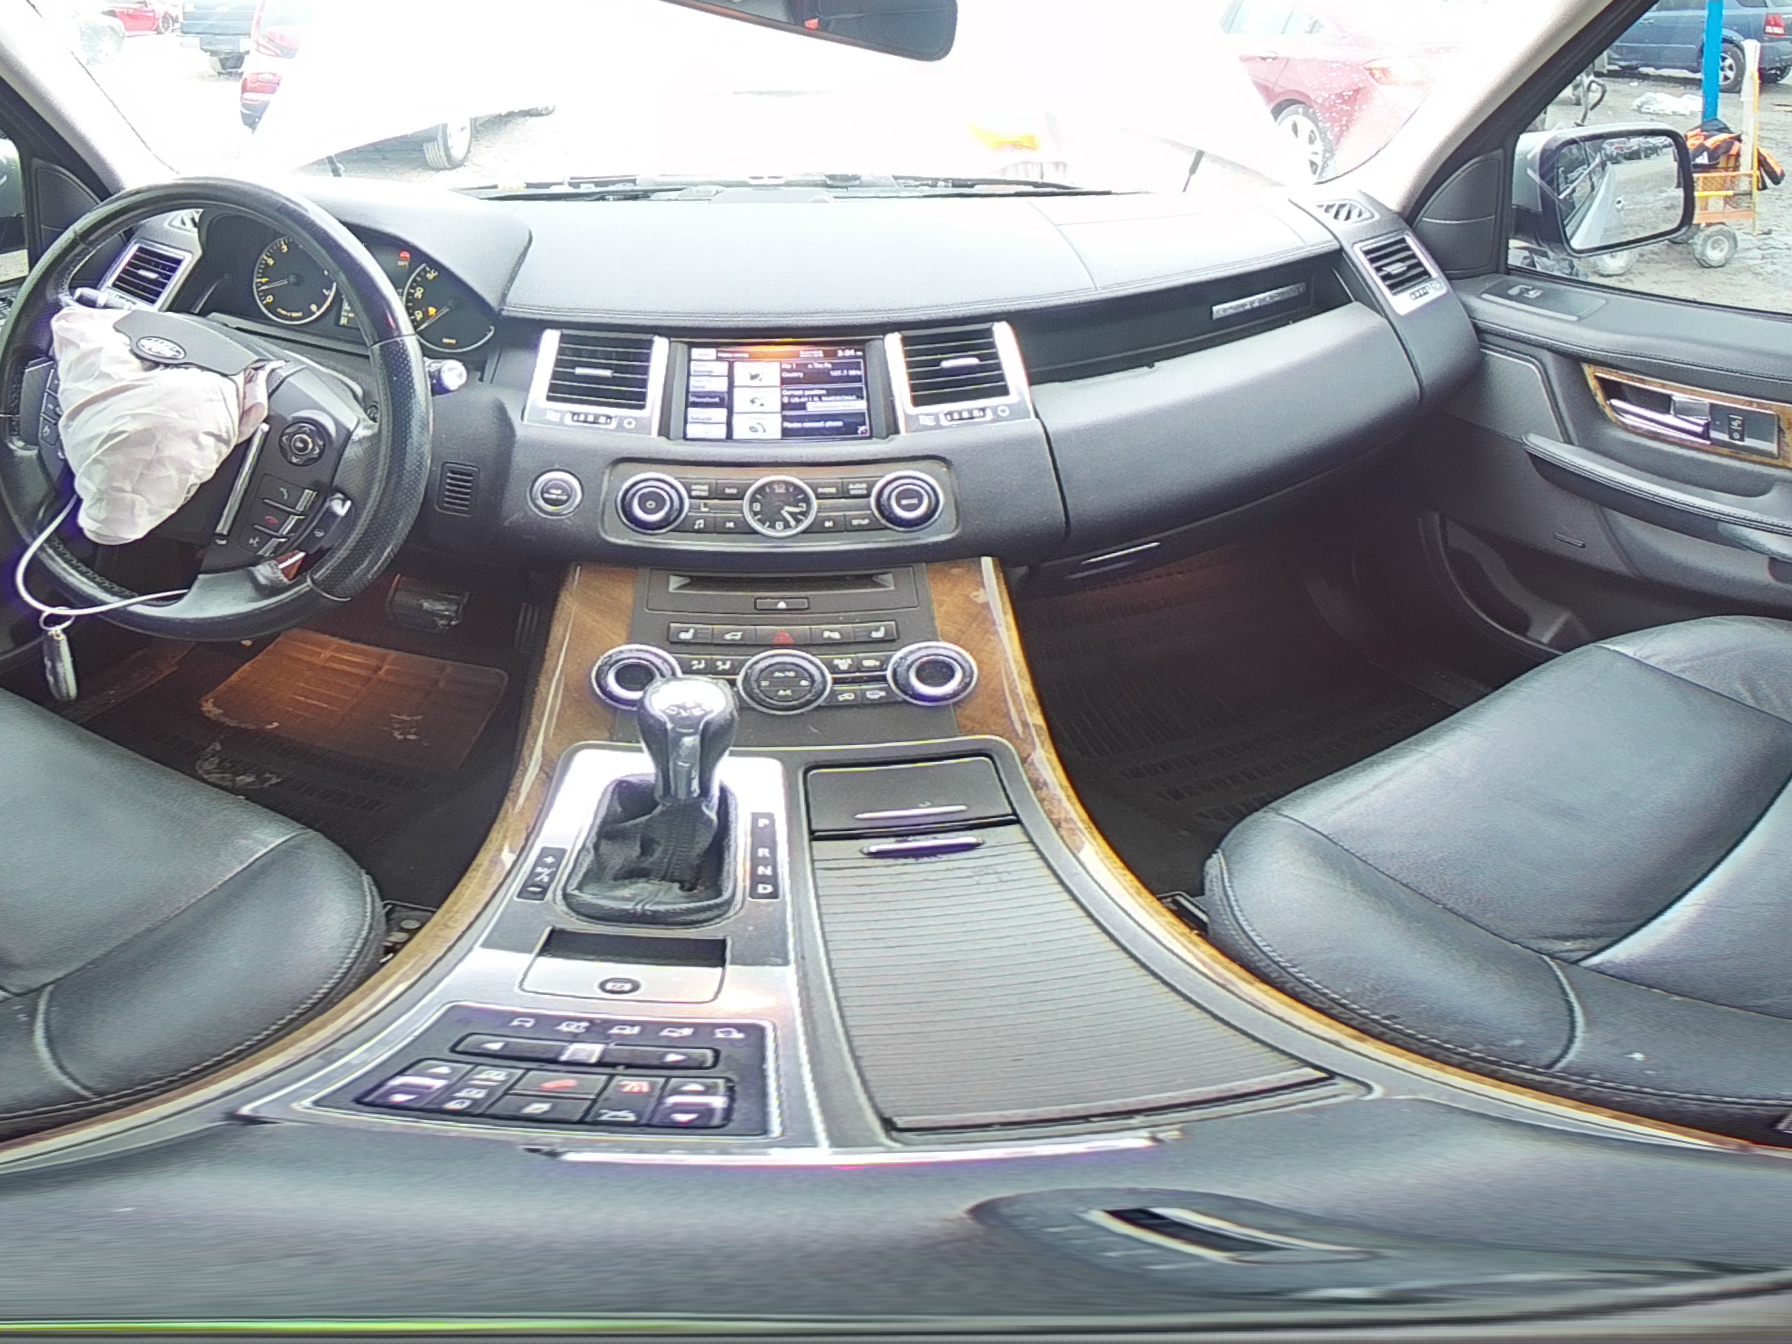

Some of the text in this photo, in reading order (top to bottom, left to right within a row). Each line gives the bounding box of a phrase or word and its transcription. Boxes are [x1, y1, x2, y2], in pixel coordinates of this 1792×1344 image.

[773, 484, 785, 493] 12
[757, 818, 770, 827] P
[757, 847, 771, 858] R
[757, 865, 773, 875] N
[757, 883, 774, 893] D
